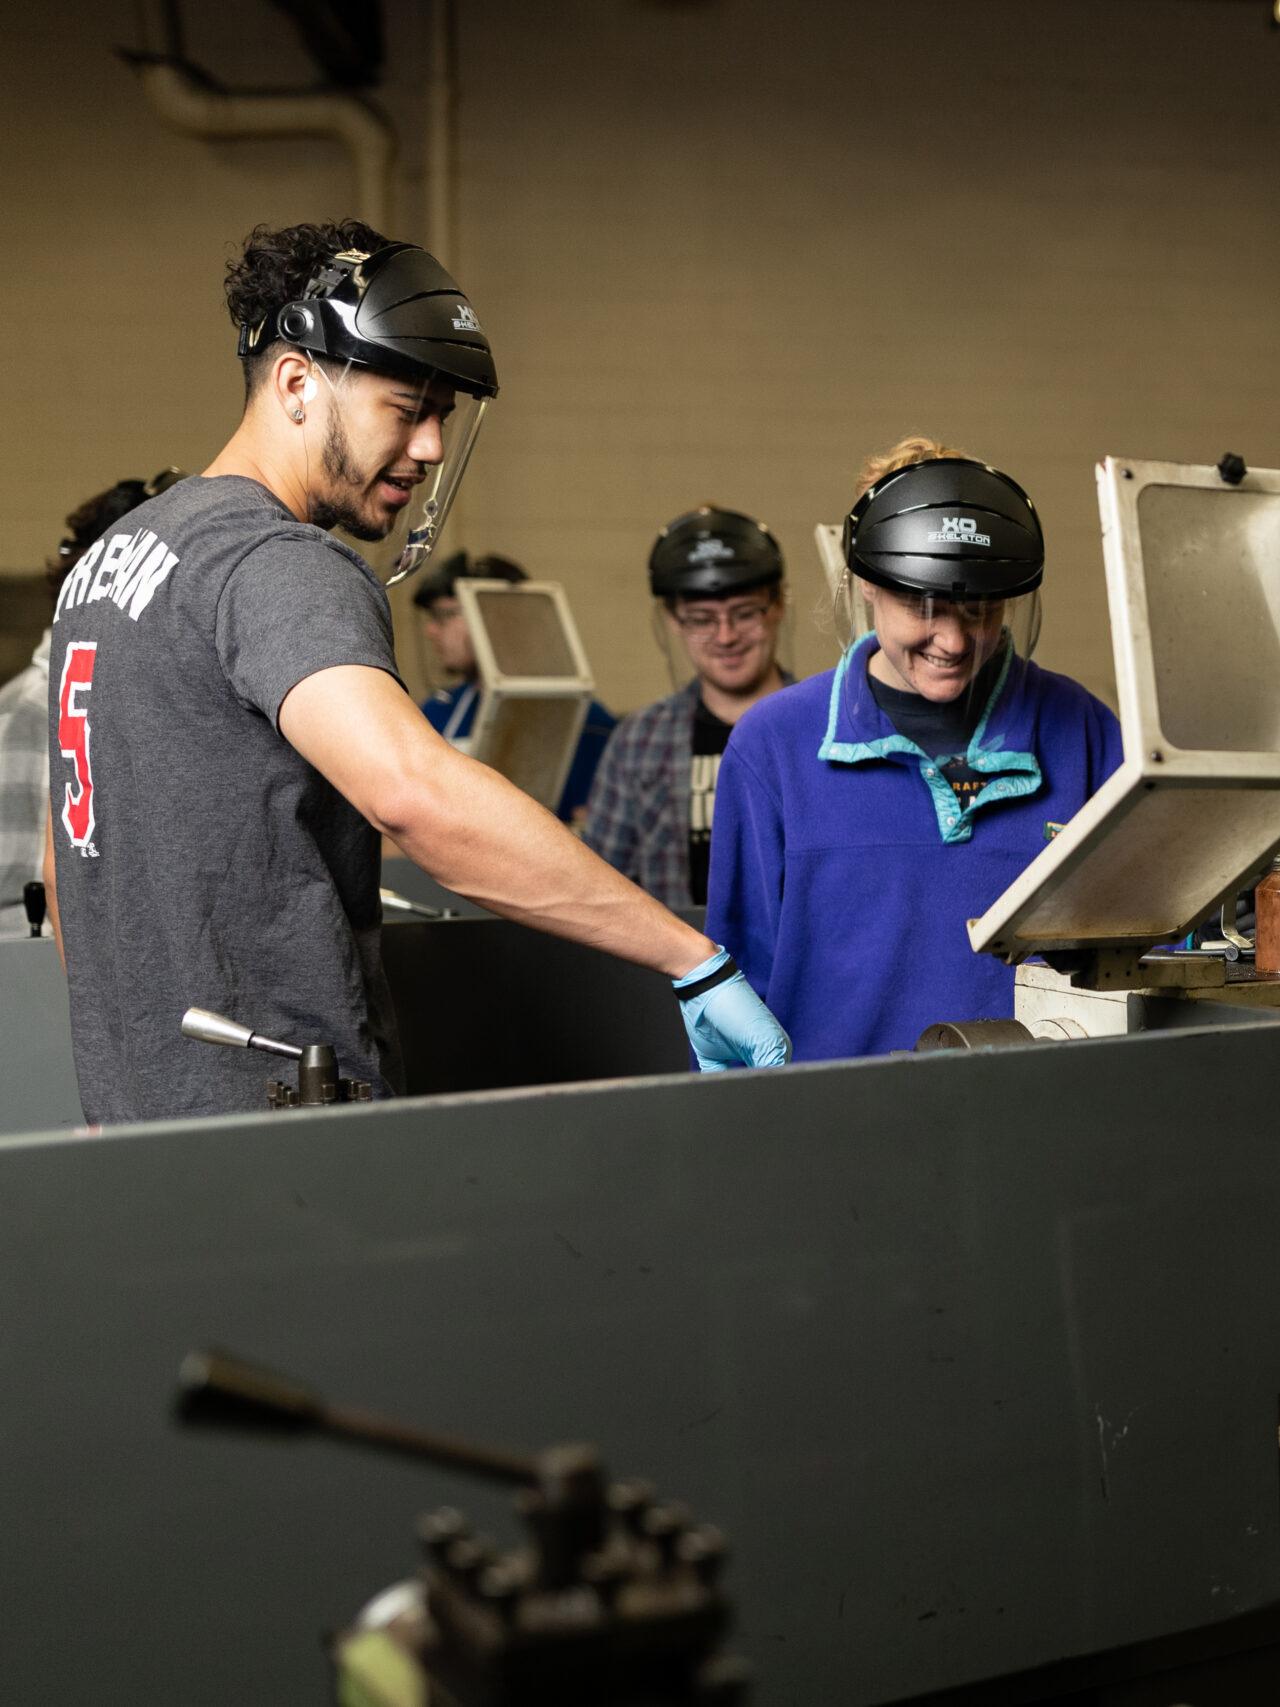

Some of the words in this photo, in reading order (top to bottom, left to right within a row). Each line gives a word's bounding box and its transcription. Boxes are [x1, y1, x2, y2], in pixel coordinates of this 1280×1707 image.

[942, 517, 977, 533] XO
[928, 532, 991, 546] SKELETON
[58, 641, 97, 847] 5
